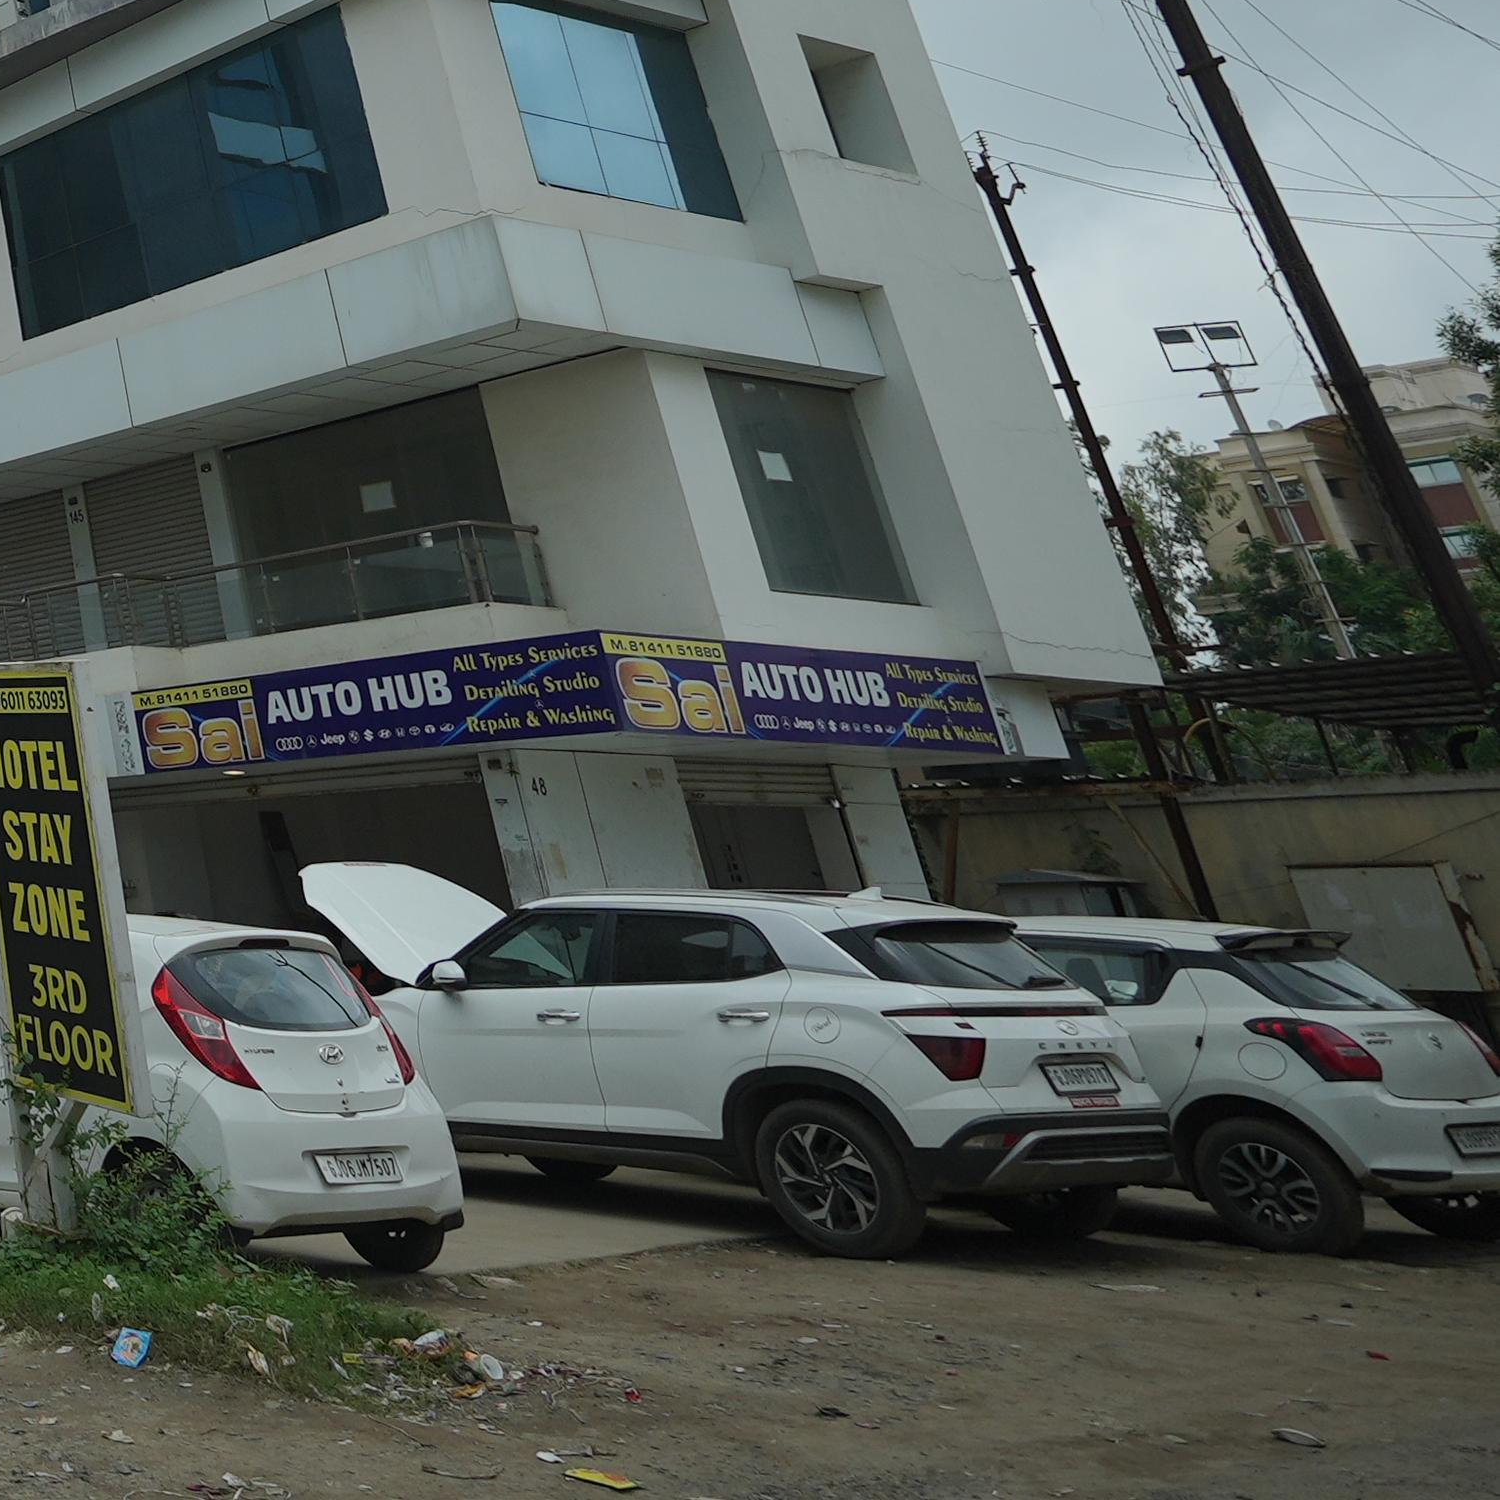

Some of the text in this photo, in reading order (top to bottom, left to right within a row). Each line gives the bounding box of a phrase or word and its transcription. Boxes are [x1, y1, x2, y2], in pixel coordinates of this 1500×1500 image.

[69, 509, 84, 524] 145
[677, 644, 722, 659] 51880
[28, 689, 66, 710] 63093
[202, 683, 249, 699] 51880
[267, 669, 452, 725] AUTO HUB
[615, 657, 747, 735] Sai
[743, 662, 891, 708] AUTO HUB
[142, 698, 265, 770] Sai
[526, 710, 541, 727] &
[942, 724, 954, 741] &
[320, 733, 346, 746] Jeep
[531, 776, 548, 796] 48
[2, 811, 72, 866] STAY
[8, 882, 91, 942] ZONE
[28, 964, 87, 1014] 3RD
[17, 1014, 117, 1077] FLOOR
